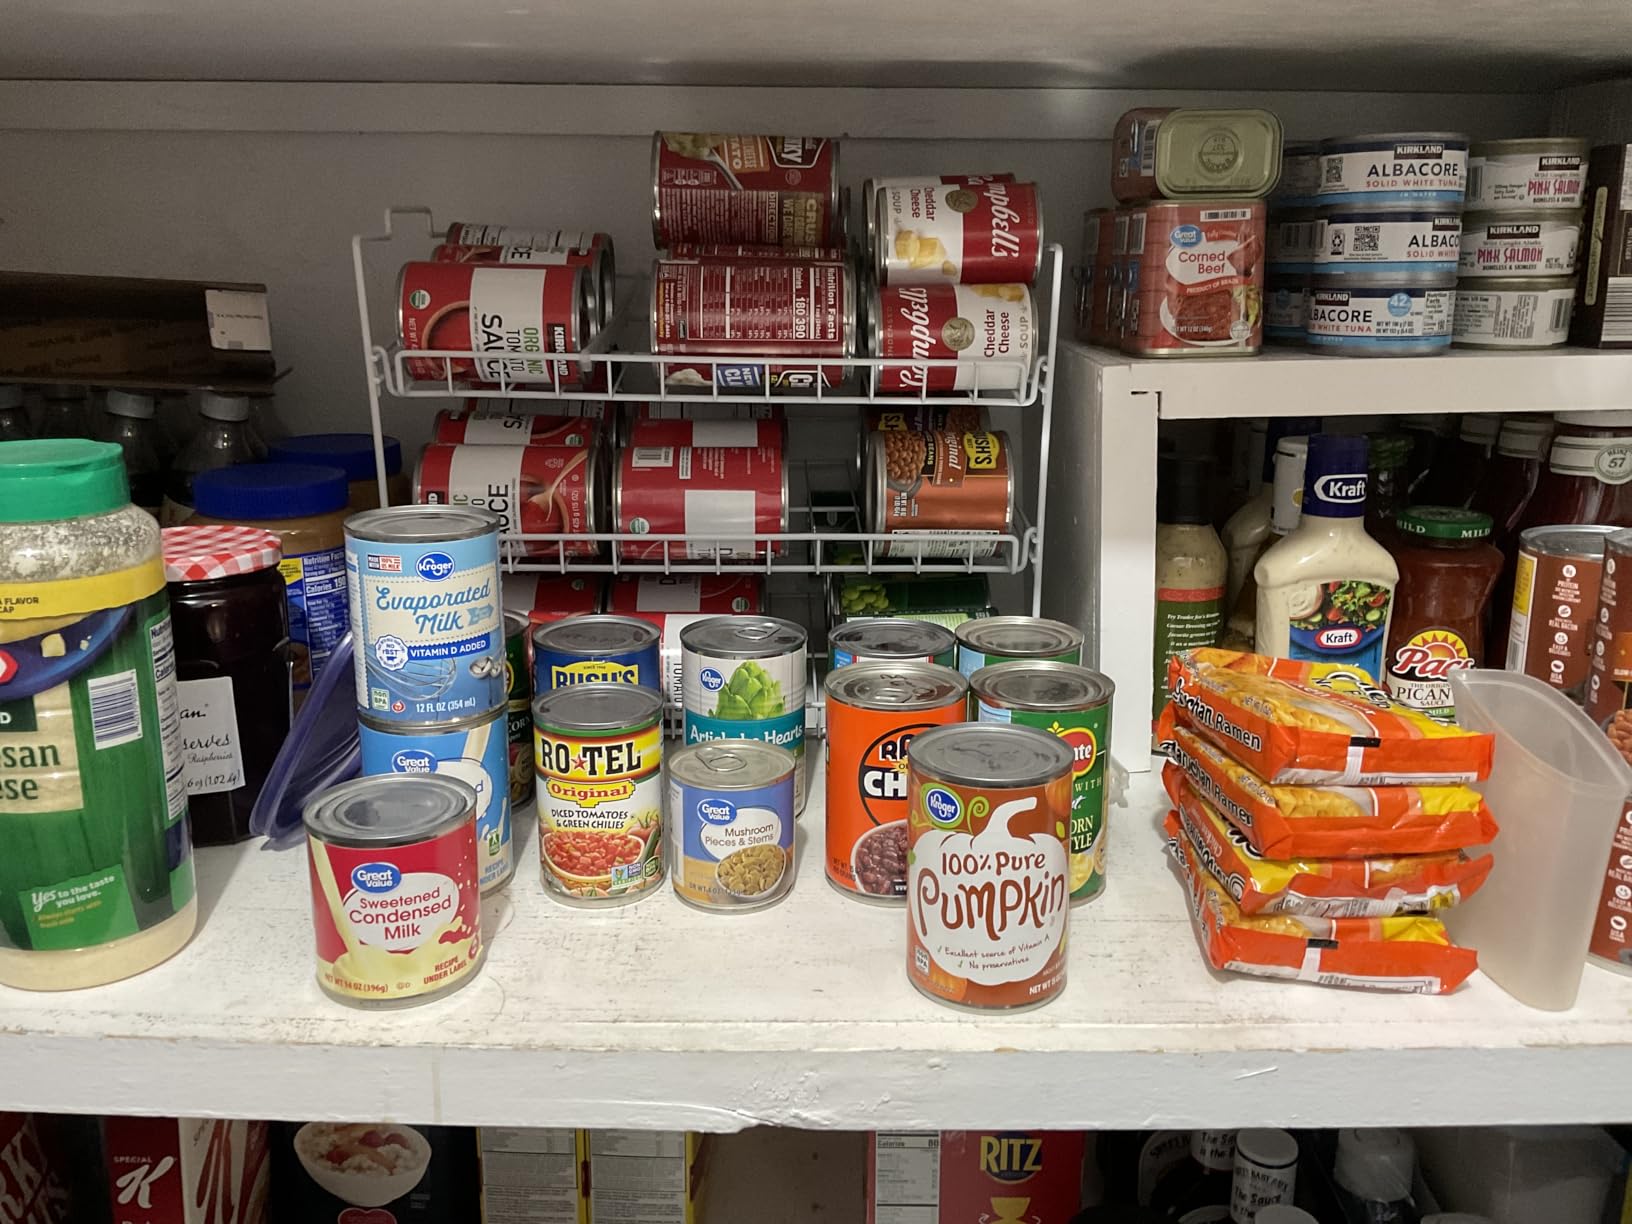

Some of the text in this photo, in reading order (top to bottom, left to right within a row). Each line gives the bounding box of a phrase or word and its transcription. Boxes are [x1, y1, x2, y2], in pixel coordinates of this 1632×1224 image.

[1396, 145, 1442, 154] KIRKLAND
[1366, 162, 1458, 178] ALBACORE
[1542, 158, 1580, 166] KIRKLAND
[1366, 179, 1398, 188] SOLID
[1403, 179, 1435, 187] WHITE
[1528, 179, 1550, 196] PINK
[1174, 230, 1196, 238] Great
[1490, 226, 1540, 234] KIRKLAND
[1178, 251, 1226, 262] Corned
[1408, 250, 1434, 258] SOLID
[1478, 248, 1544, 264] PINK SALMON
[1198, 263, 1226, 274] Beef
[828, 268, 836, 340] Nutrition Facts
[1391, 294, 1408, 306] 42
[796, 296, 806, 339] 180 390
[984, 308, 996, 358] Cheddar
[998, 312, 1010, 354] Cheese
[1020, 316, 1028, 349] SOUP
[524, 327, 544, 375] ORGNIC
[1608, 457, 1626, 468] 57
[1329, 481, 1366, 498] Kraft
[1460, 528, 1491, 538] MILD
[418, 556, 453, 576] Kroger
[306, 583, 332, 594] Calories
[4, 597, 39, 606] FLAVOR
[376, 578, 491, 616] Evaporated
[415, 610, 465, 636] Milk
[1326, 632, 1353, 645] Kraft
[410, 640, 486, 658] VITAMIN D ADDED
[701, 670, 722, 688] Kroger
[416, 697, 476, 713] 12 FL OZ (354 mL)
[764, 724, 803, 745] Hearts
[1214, 712, 1262, 753] Ramen
[396, 756, 430, 768] Great
[404, 764, 430, 774] Value
[1075, 776, 1102, 792] WITH
[551, 784, 628, 802] Original
[702, 804, 730, 815] Great
[930, 794, 956, 817] Kroger
[552, 808, 628, 820] DICED TOMATOES
[708, 812, 730, 820] Value
[556, 820, 624, 829] & GREEN CHILIES
[724, 824, 774, 838] Mushroom
[705, 834, 774, 846] Pieces & Stems
[942, 852, 1046, 876] 100% Pure
[358, 870, 393, 882] Great
[366, 878, 395, 888] Value
[58, 874, 116, 900] to the taste
[56, 896, 76, 908] you
[360, 886, 440, 909] Sweetened
[917, 868, 1065, 941] Pumpkin
[350, 895, 452, 924] Condensed
[384, 922, 422, 940] Milk
[944, 934, 1050, 959] Excellent source of Vitamin A
[434, 956, 459, 972] RECIPE
[916, 956, 928, 968] BPA
[969, 956, 1030, 971] No preservatives
[424, 960, 468, 984] UNDER LABEL
[352, 982, 362, 992] OZ
[364, 984, 388, 994] (396g)
[1029, 985, 1041, 996] NET
[928, 1139, 939, 1148] 80
[114, 1156, 152, 1164] SPECIAL
[980, 1136, 1042, 1173] RITZ
[115, 1155, 176, 1209] K
